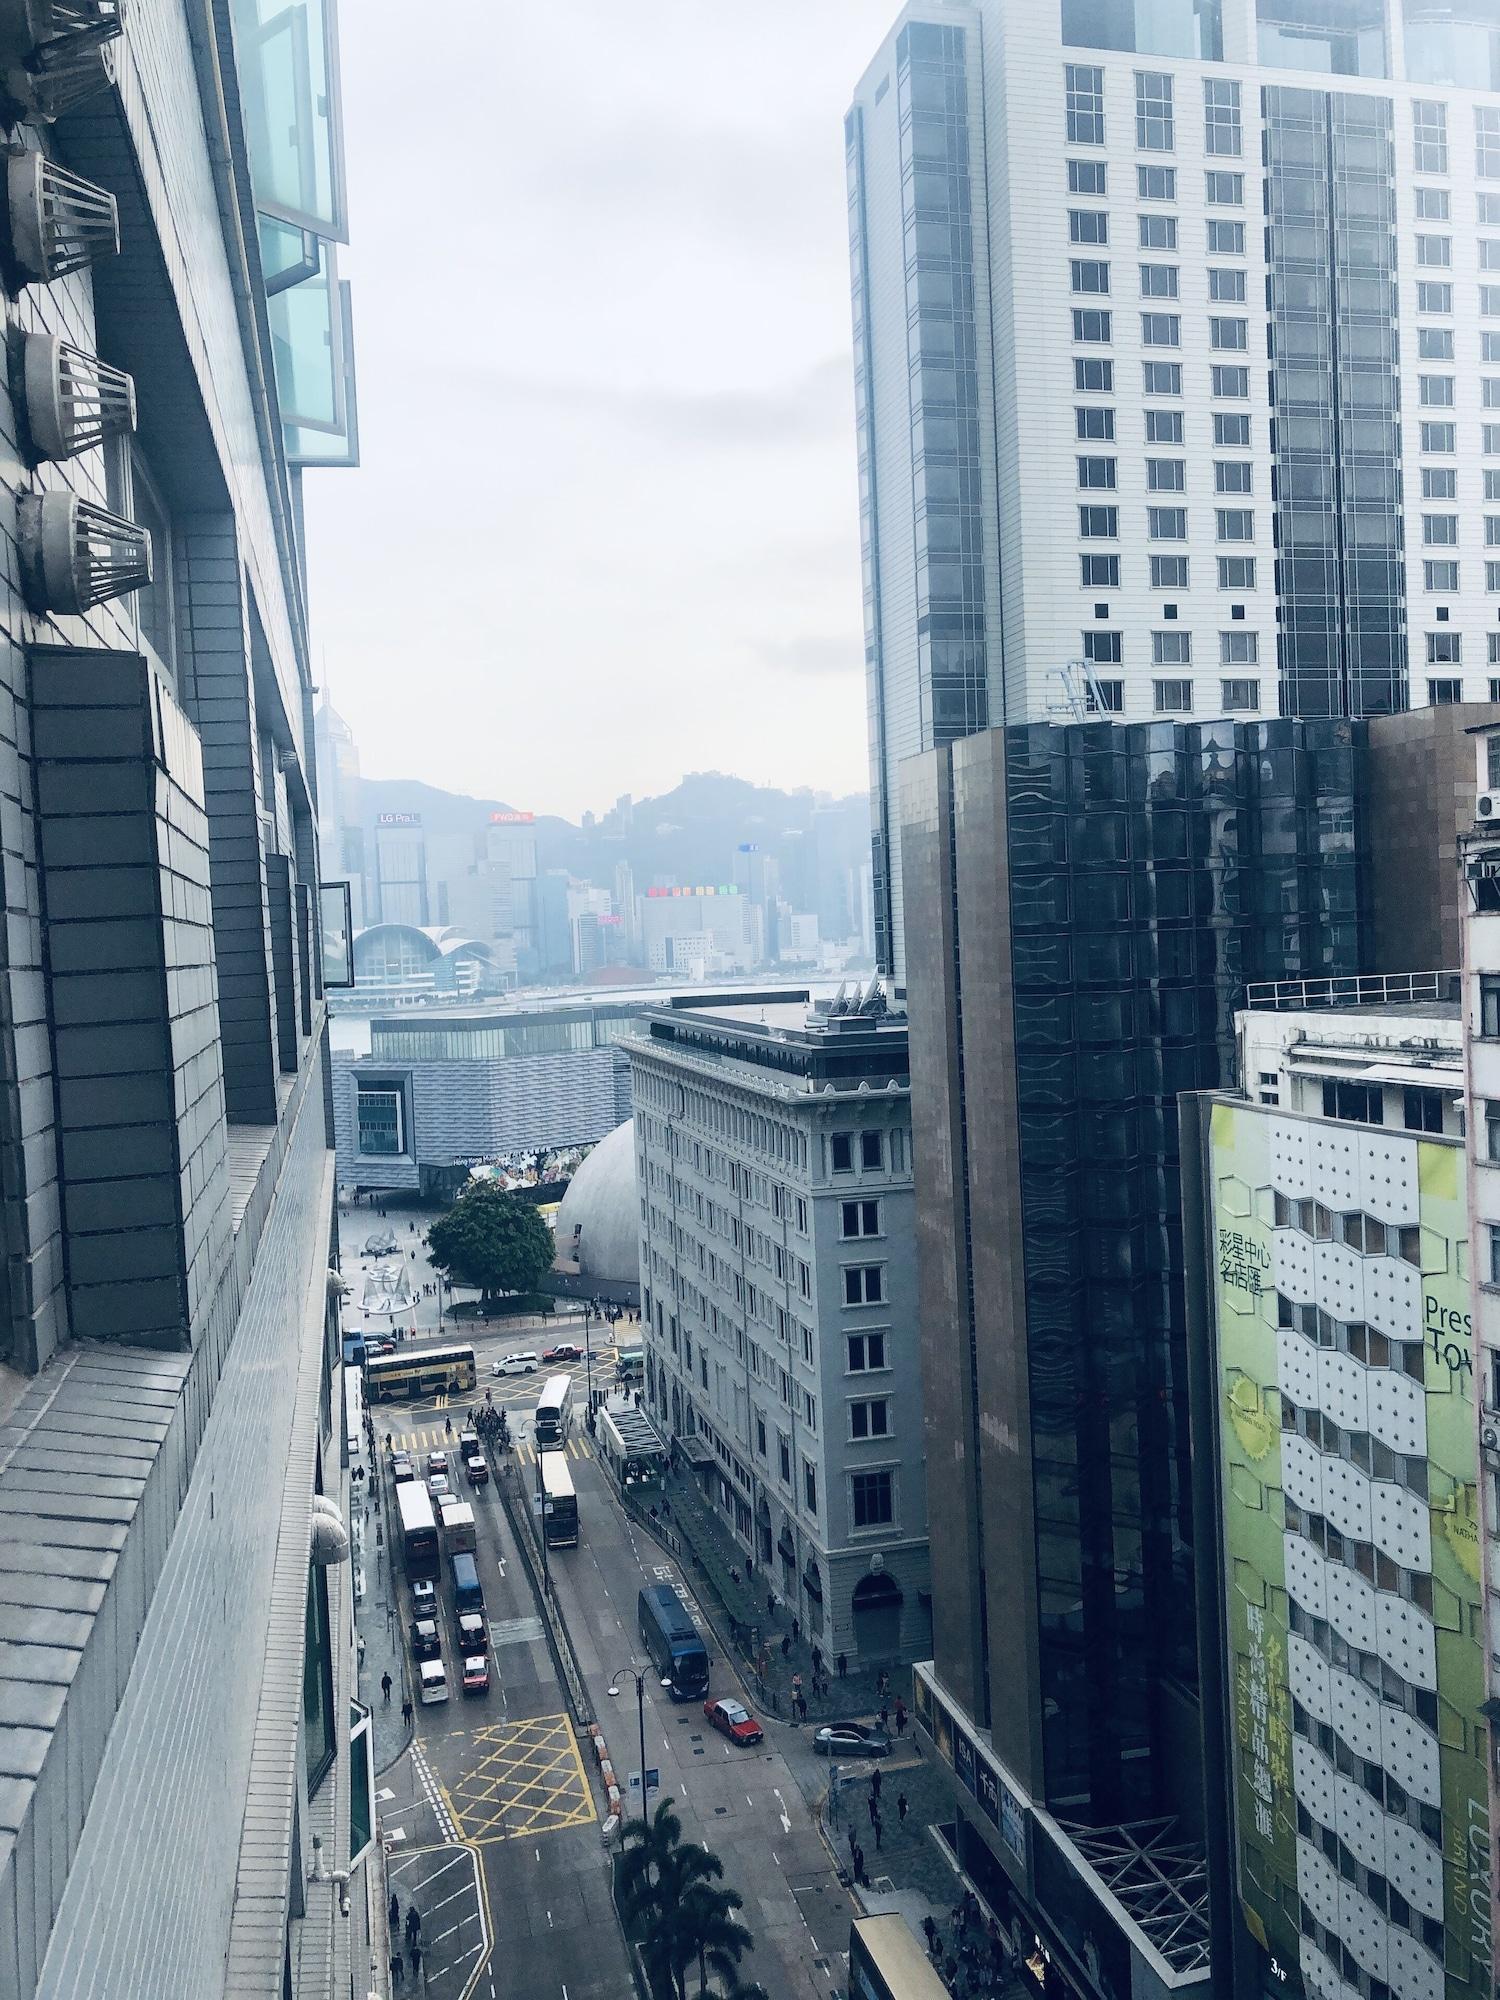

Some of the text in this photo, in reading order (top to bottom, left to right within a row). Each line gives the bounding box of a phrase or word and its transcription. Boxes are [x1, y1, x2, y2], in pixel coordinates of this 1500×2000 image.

[380, 814, 393, 823] LG
[1219, 1228, 1271, 1269] 彩星中心
[1271, 1957, 1288, 1982] 3/F
